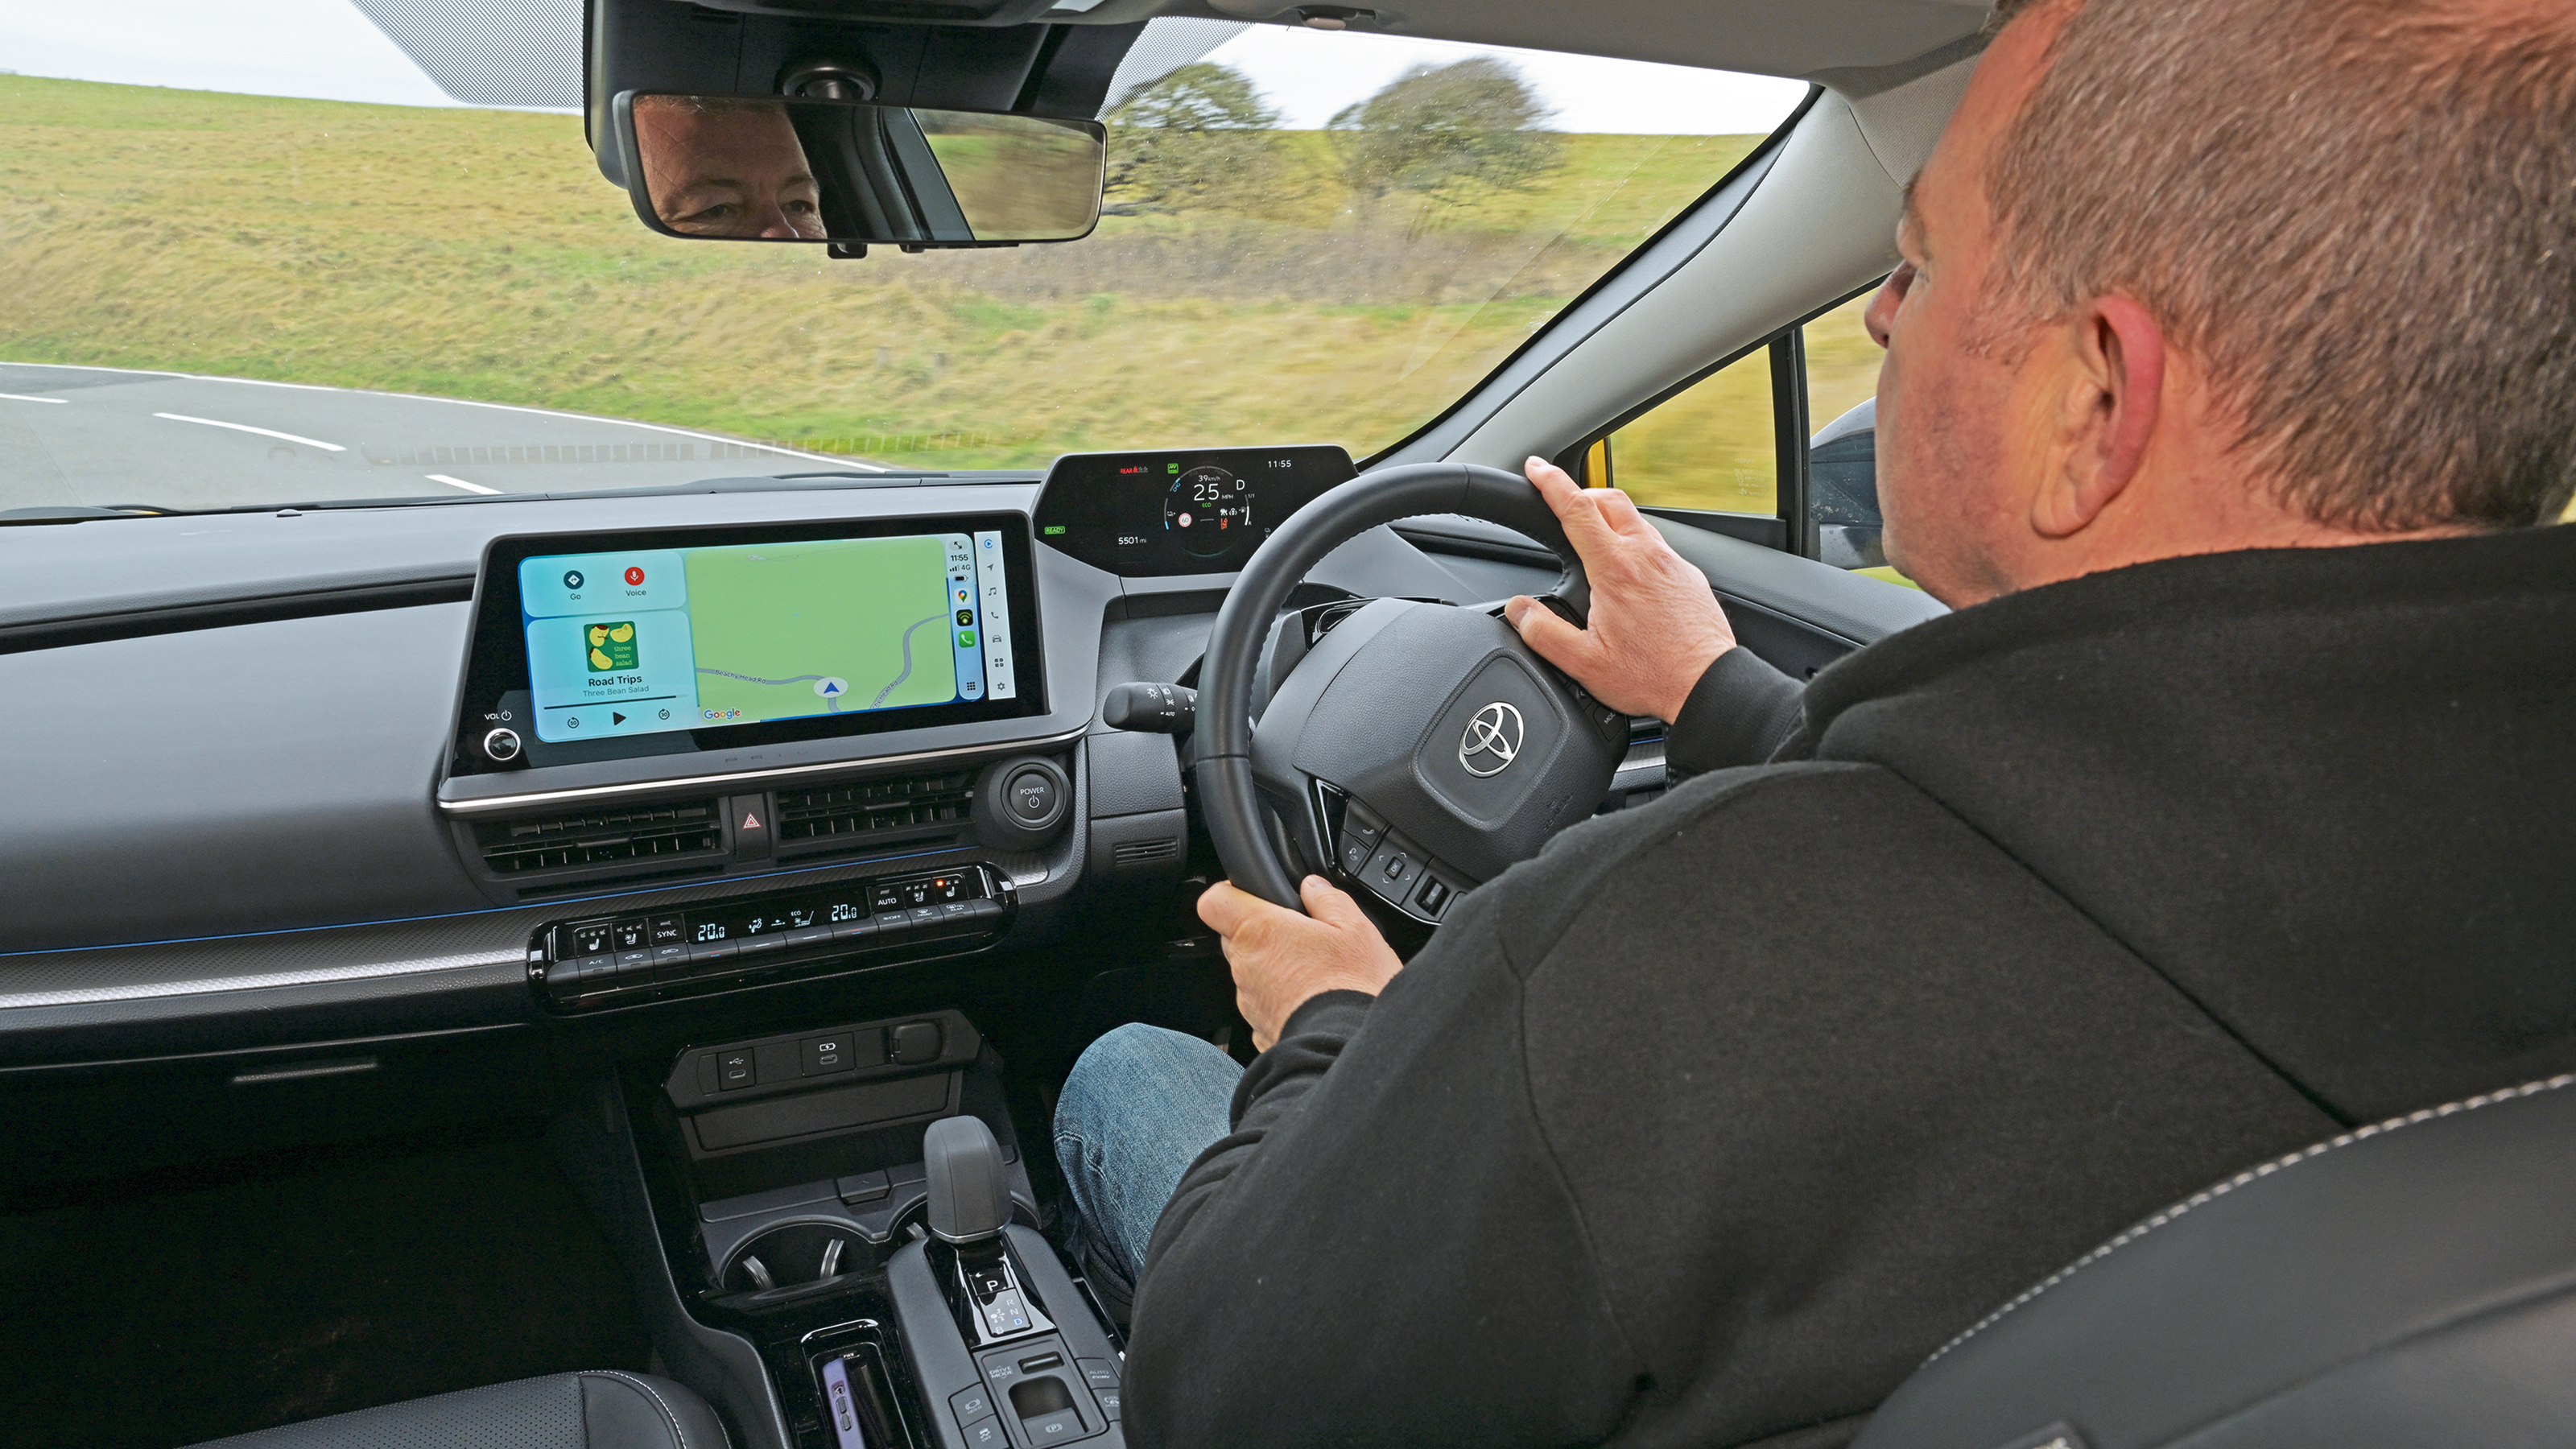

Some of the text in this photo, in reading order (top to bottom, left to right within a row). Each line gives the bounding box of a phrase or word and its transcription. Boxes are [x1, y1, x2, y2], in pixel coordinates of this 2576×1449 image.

[1268, 460, 1292, 468] 11:55
[1236, 479, 1245, 490] D
[1194, 483, 1220, 501] 25
[1118, 536, 1138, 545] 5501
[950, 554, 969, 562] 11:55
[570, 592, 581, 601] Go
[625, 588, 646, 597] Voice
[715, 669, 738, 679] Beachy
[740, 675, 757, 683] Head
[588, 675, 642, 687] Road Trips
[607, 687, 626, 696] Bean
[628, 685, 650, 693] Salad
[704, 708, 741, 720] Google
[1020, 786, 1045, 795] POWER
[877, 898, 897, 906] AUTO
[832, 903, 857, 921] 20.0
[657, 929, 677, 939] SYNC
[698, 923, 725, 941] 20.0
[986, 1280, 998, 1292] P
[1013, 1318, 1023, 1326] D
[995, 1326, 1005, 1335] B
[989, 1366, 1011, 1375] DRIVE
[990, 1370, 1013, 1379] MODE
